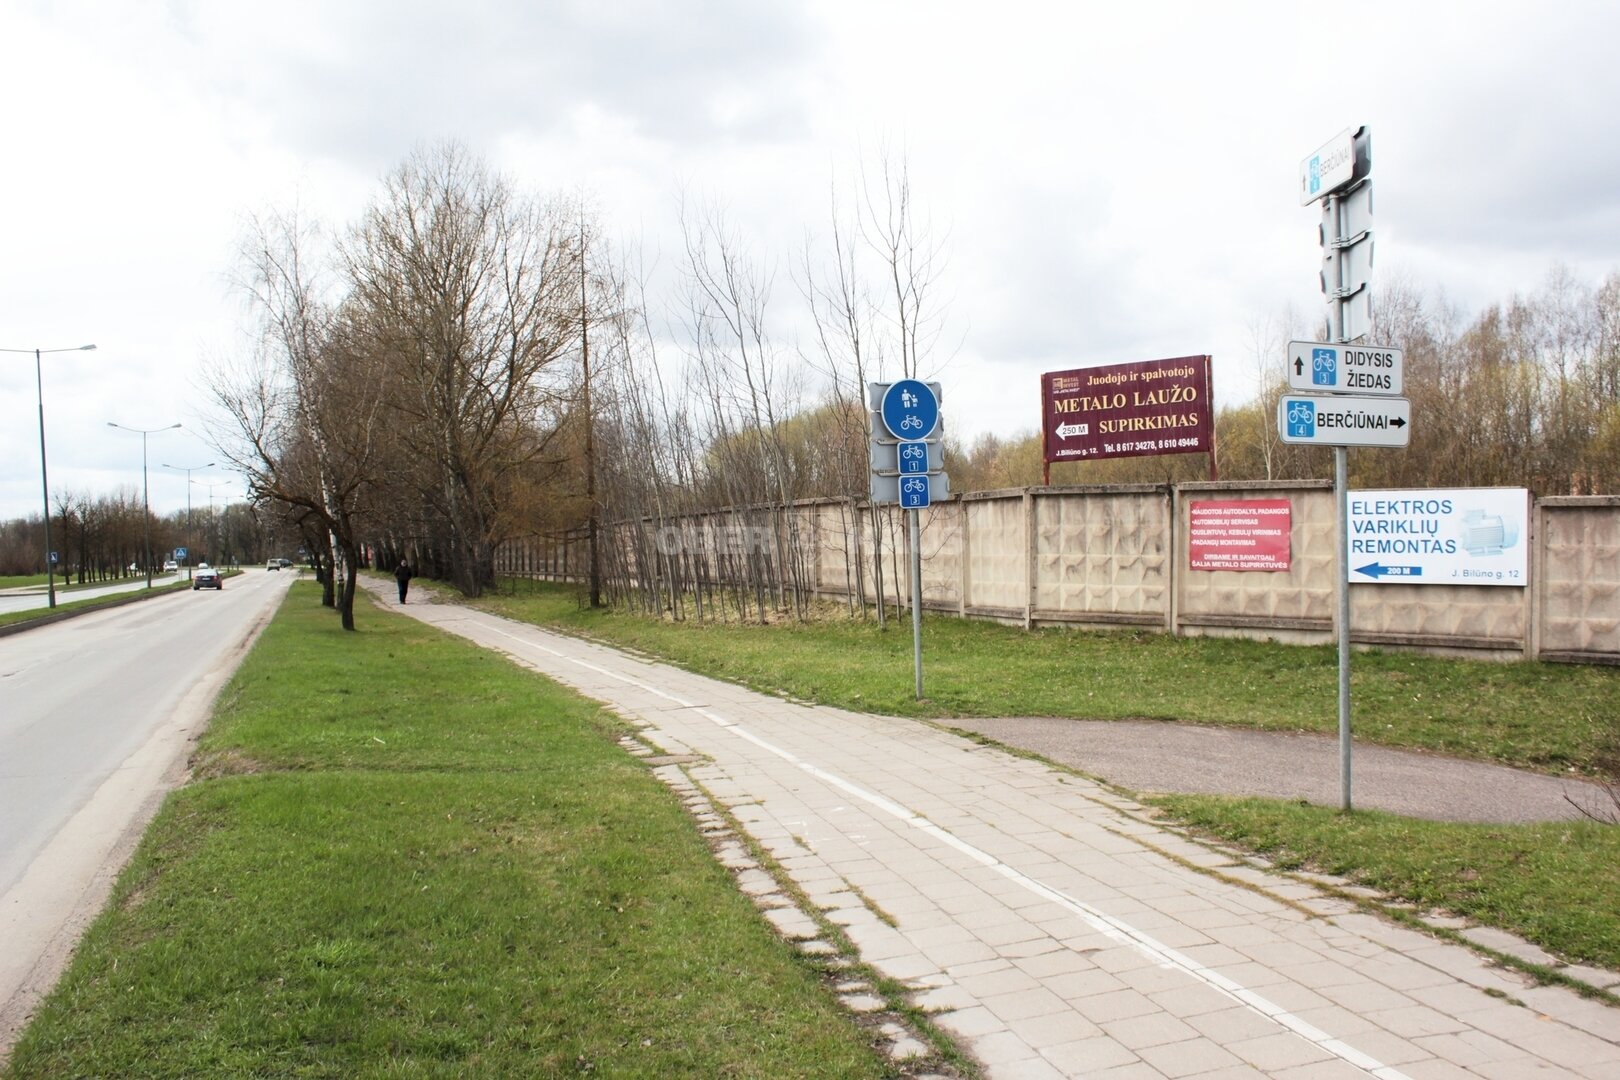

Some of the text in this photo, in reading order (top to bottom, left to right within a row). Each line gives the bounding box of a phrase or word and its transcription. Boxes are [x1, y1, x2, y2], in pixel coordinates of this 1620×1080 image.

[1345, 350, 1393, 368] DIDYSIS
[1087, 365, 1195, 386] Juodojo ir spalvotojo
[1322, 373, 1327, 383] 3
[1347, 369, 1391, 389] ŽIEDAS
[1054, 384, 1197, 414] METALO LAUŽO
[1099, 413, 1199, 434] SUPIRKIMAS
[1317, 410, 1388, 429] BERČIŪNAI
[1062, 427, 1077, 435] 250
[1298, 426, 1304, 435] 4
[1104, 443, 1115, 453] Tel.
[1116, 443, 1121, 452] 8
[1122, 442, 1134, 451] 617
[1158, 440, 1163, 449] 8
[1164, 439, 1177, 448] 610
[913, 496, 918, 504] 3
[1352, 499, 1453, 515] ELEKTROS
[1353, 520, 1438, 538] VARIKLIŲ
[1352, 539, 1456, 554] REMONTAS
[1387, 567, 1410, 575] 200 M
[1452, 569, 1460, 577] J.
[1496, 571, 1505, 580] g.
[1508, 570, 1519, 578] 12
